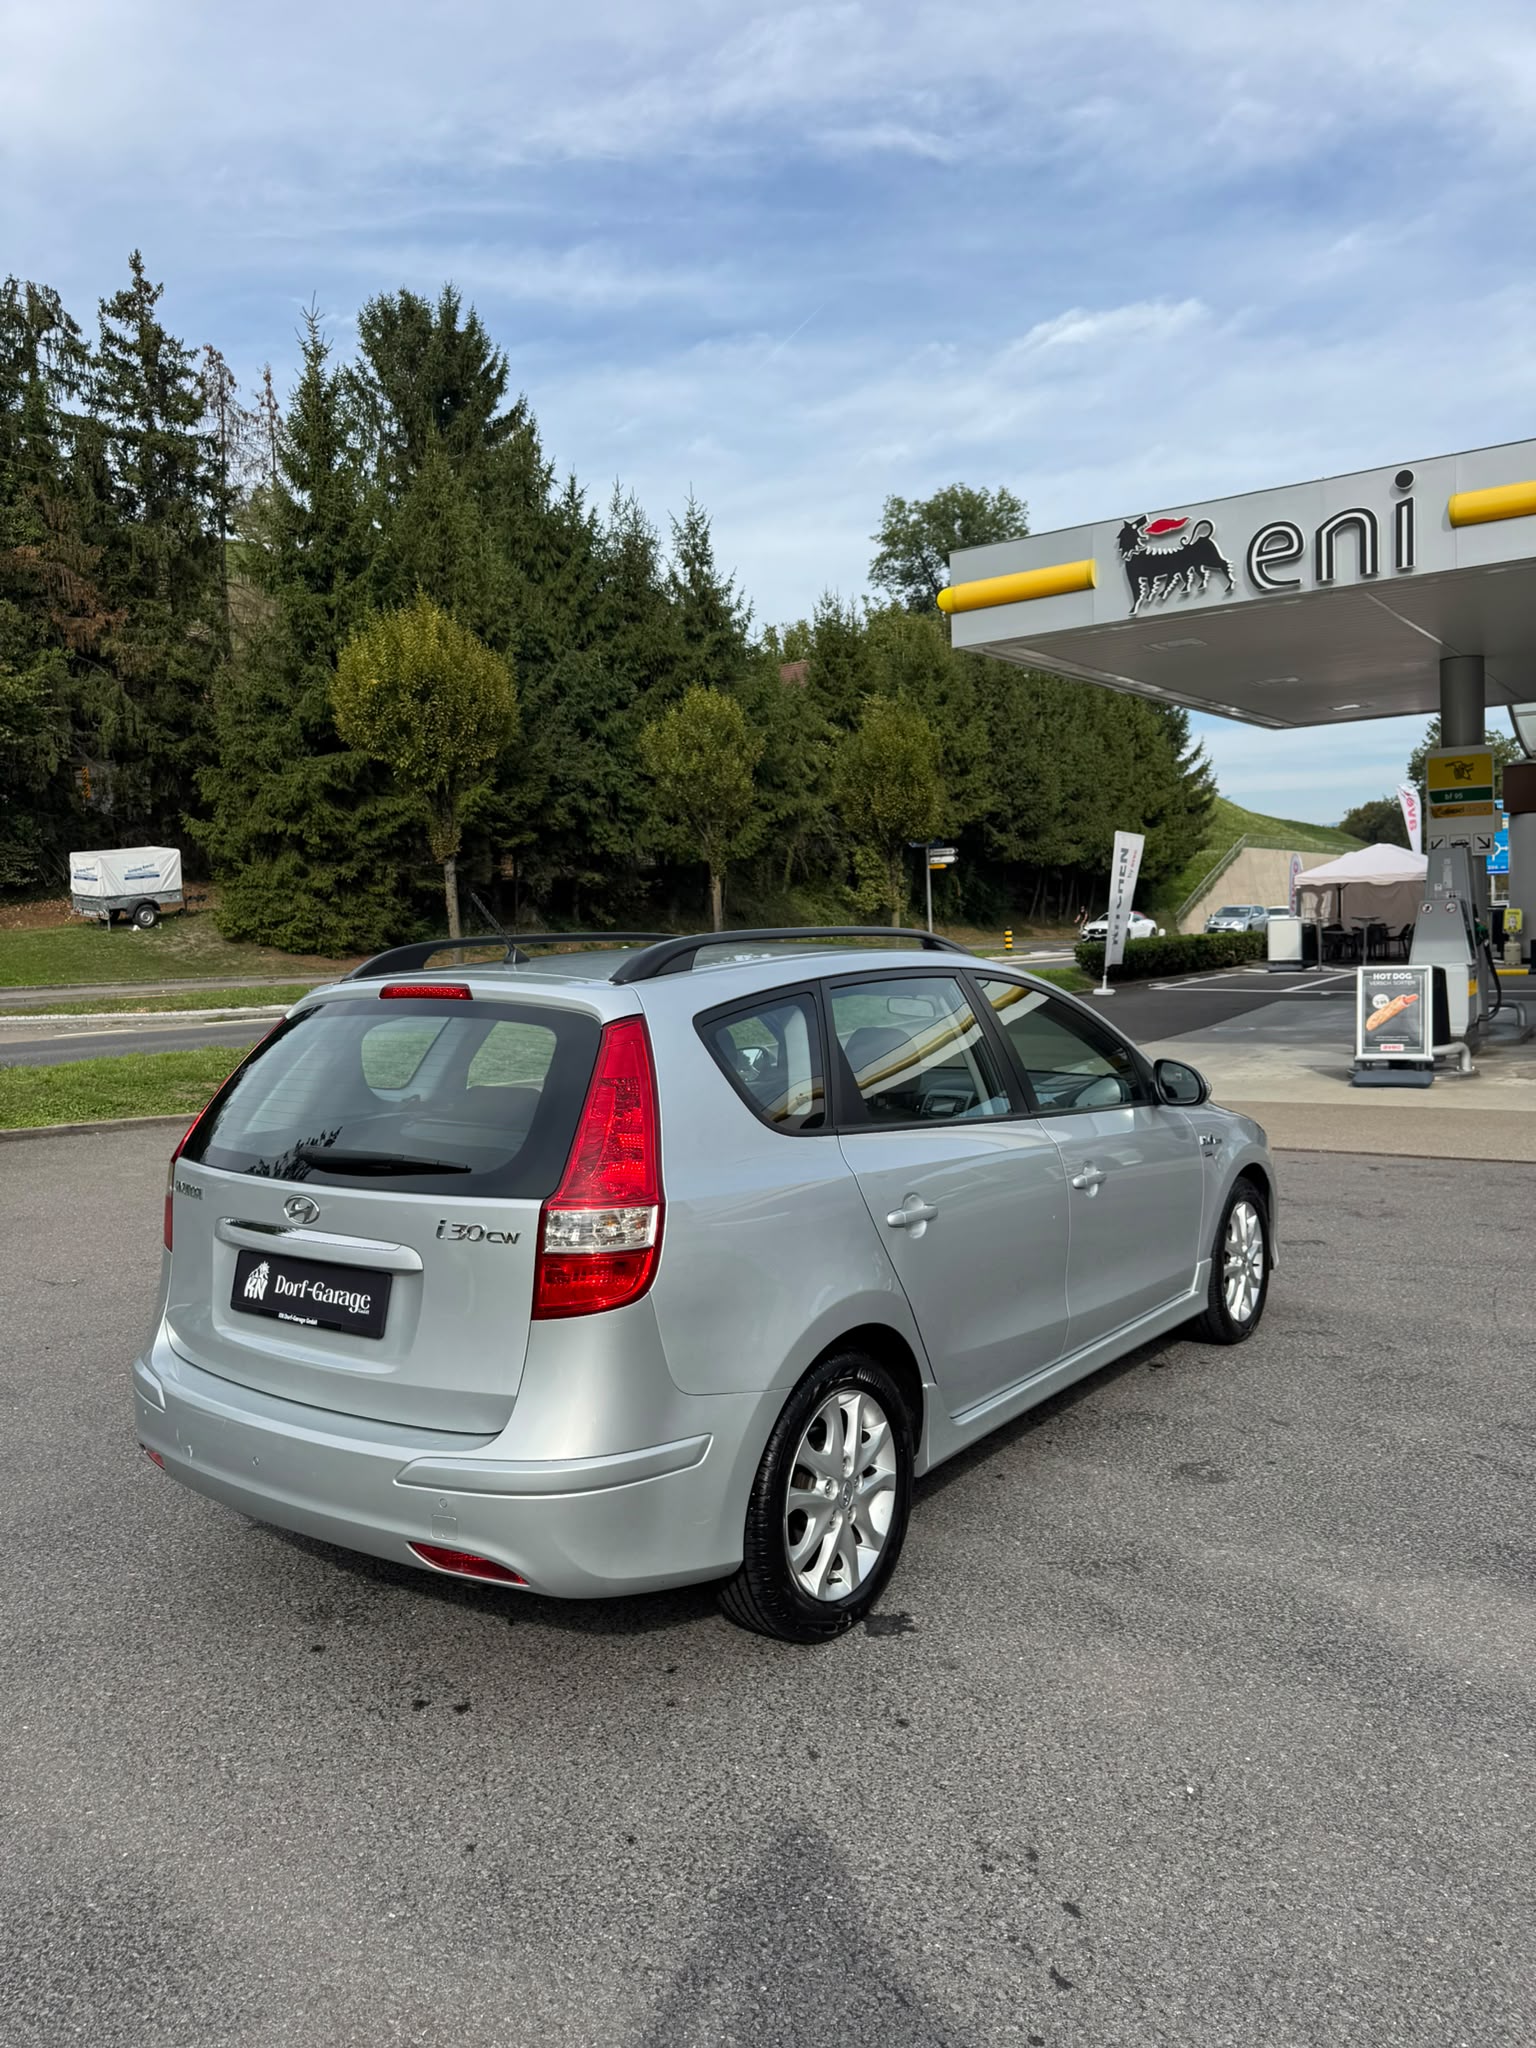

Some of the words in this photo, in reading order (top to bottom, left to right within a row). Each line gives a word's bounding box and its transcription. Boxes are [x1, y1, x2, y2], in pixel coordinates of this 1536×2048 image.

[1246, 469, 1416, 591] eni
[1372, 972, 1391, 981] HOT
[1392, 972, 1412, 981] DOG
[274, 1274, 371, 1314] Dorf-Garage
